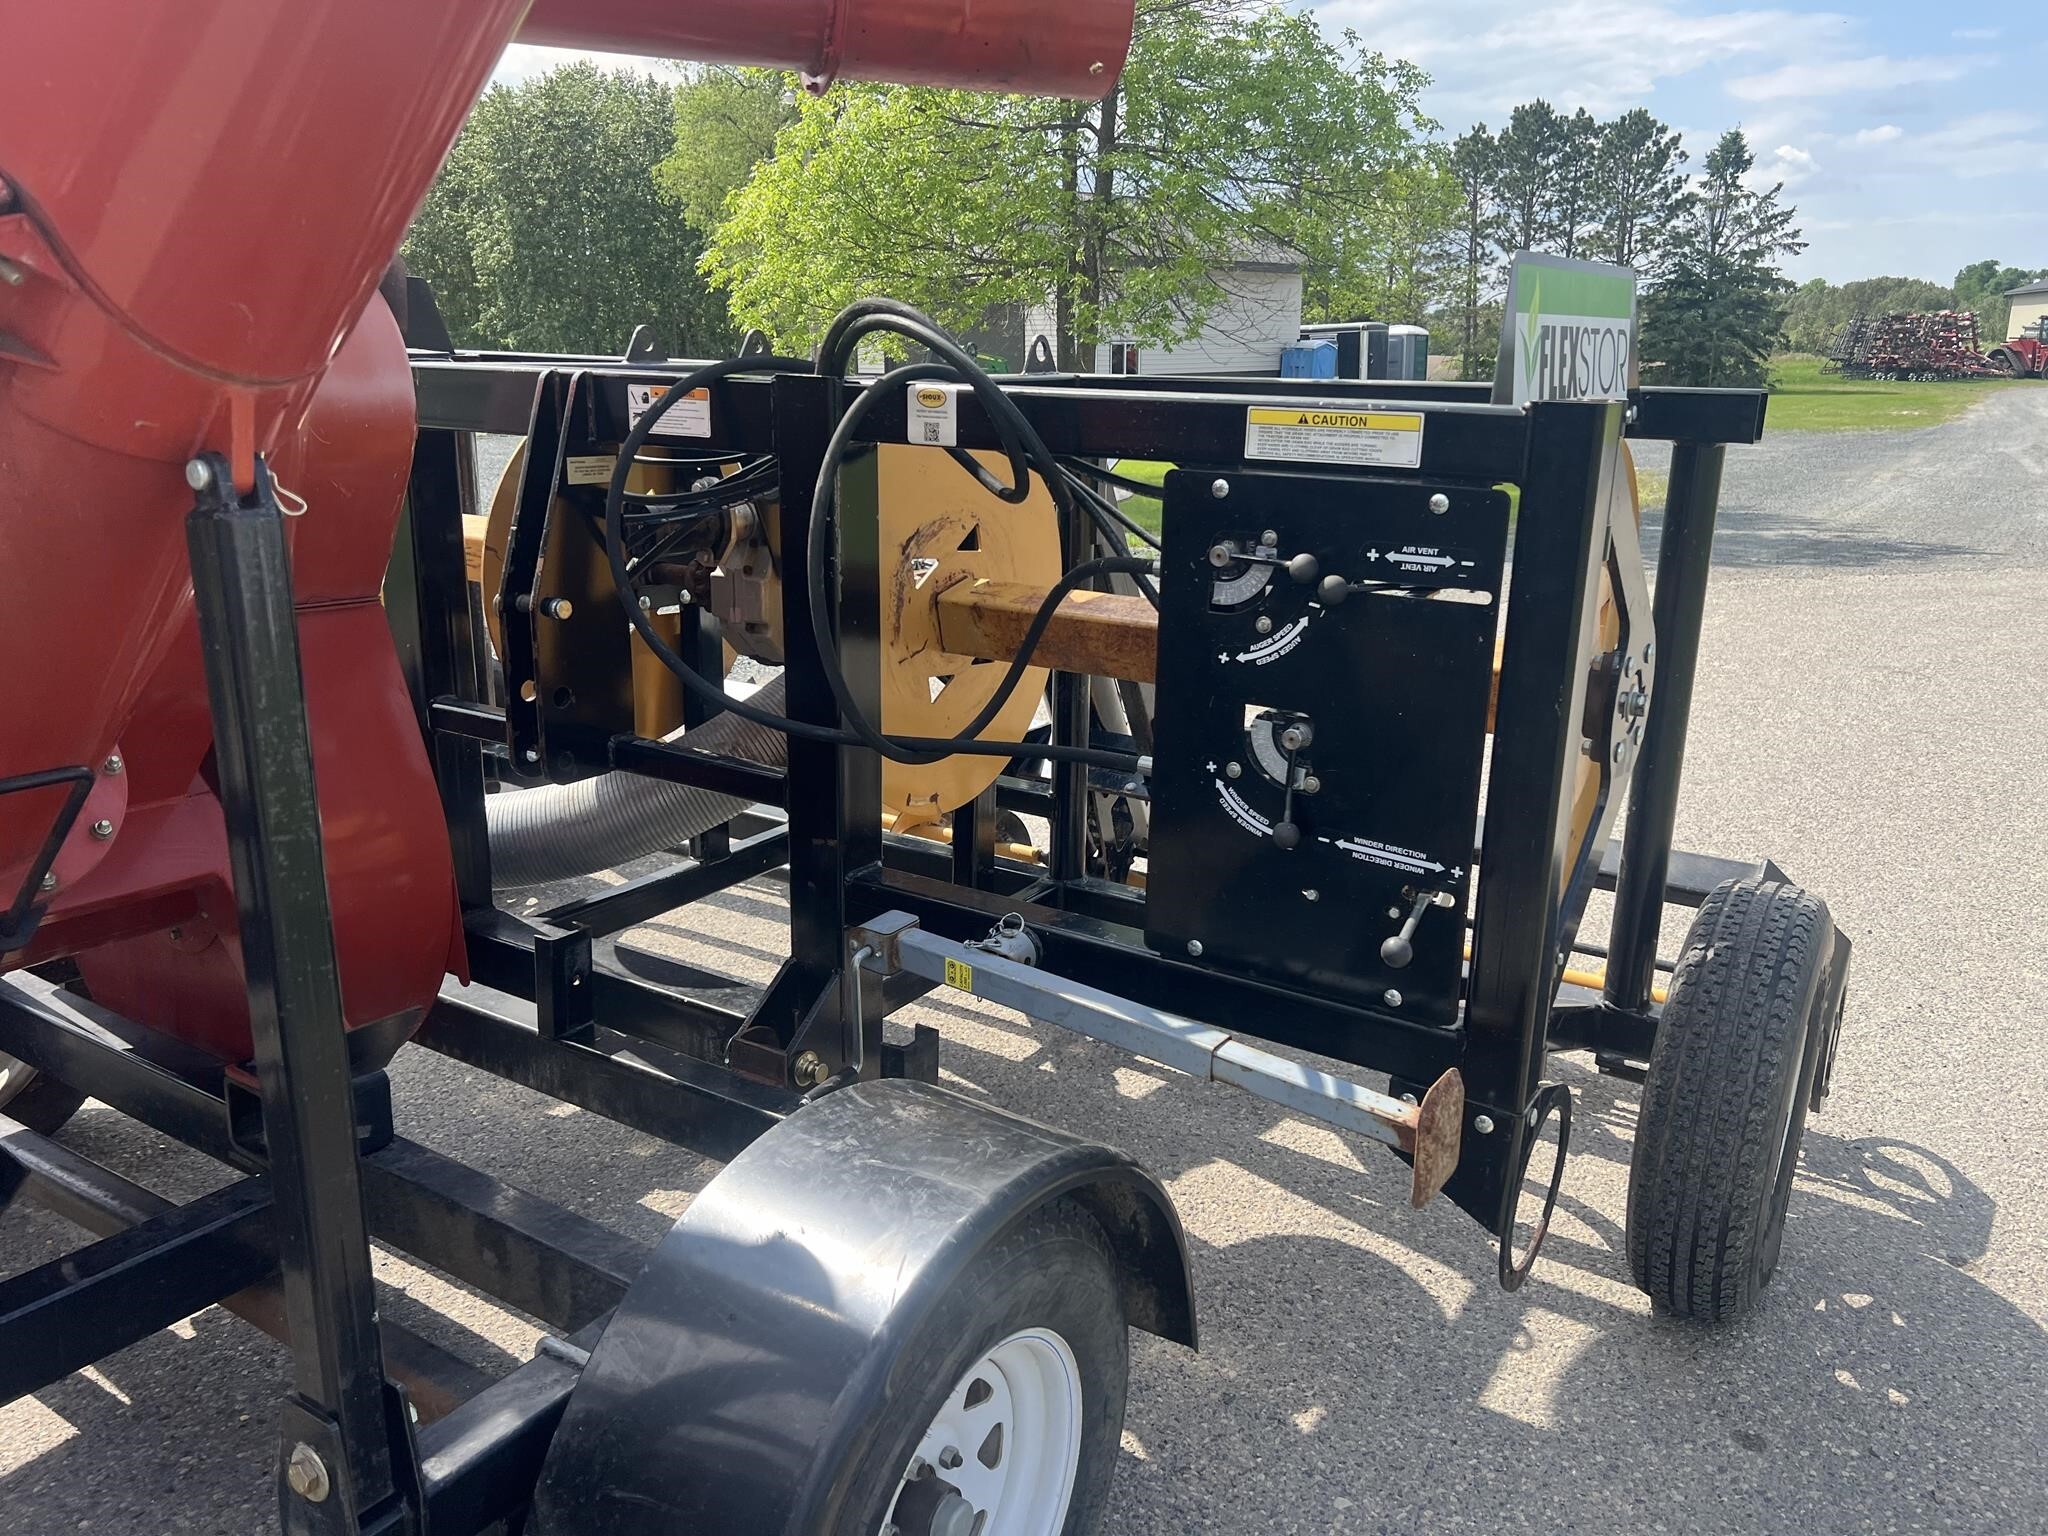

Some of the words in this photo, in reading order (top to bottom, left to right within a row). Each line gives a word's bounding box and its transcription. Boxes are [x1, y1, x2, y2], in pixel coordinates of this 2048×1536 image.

[1539, 325, 1628, 400] FLEXSTOR
[1312, 414, 1367, 427] CAUTION
[1401, 546, 1416, 554] AIR
[1417, 547, 1440, 556] VENT
[1400, 563, 1422, 572] VENT
[1423, 564, 1438, 573] AIR
[1249, 637, 1274, 652] AUGER
[1272, 623, 1293, 642] SPEED
[1278, 635, 1302, 656] AUGER
[1255, 652, 1280, 665] SPEED
[1219, 797, 1238, 819] SPEED
[1228, 786, 1250, 811] WINDER
[1247, 808, 1270, 826] SPEED
[1236, 816, 1263, 838] WINDER
[1353, 836, 1384, 850] WINDER
[1384, 844, 1427, 860] DIRECTION
[1351, 851, 1393, 867] DIRECTION
[1393, 861, 1425, 875] WINDER
